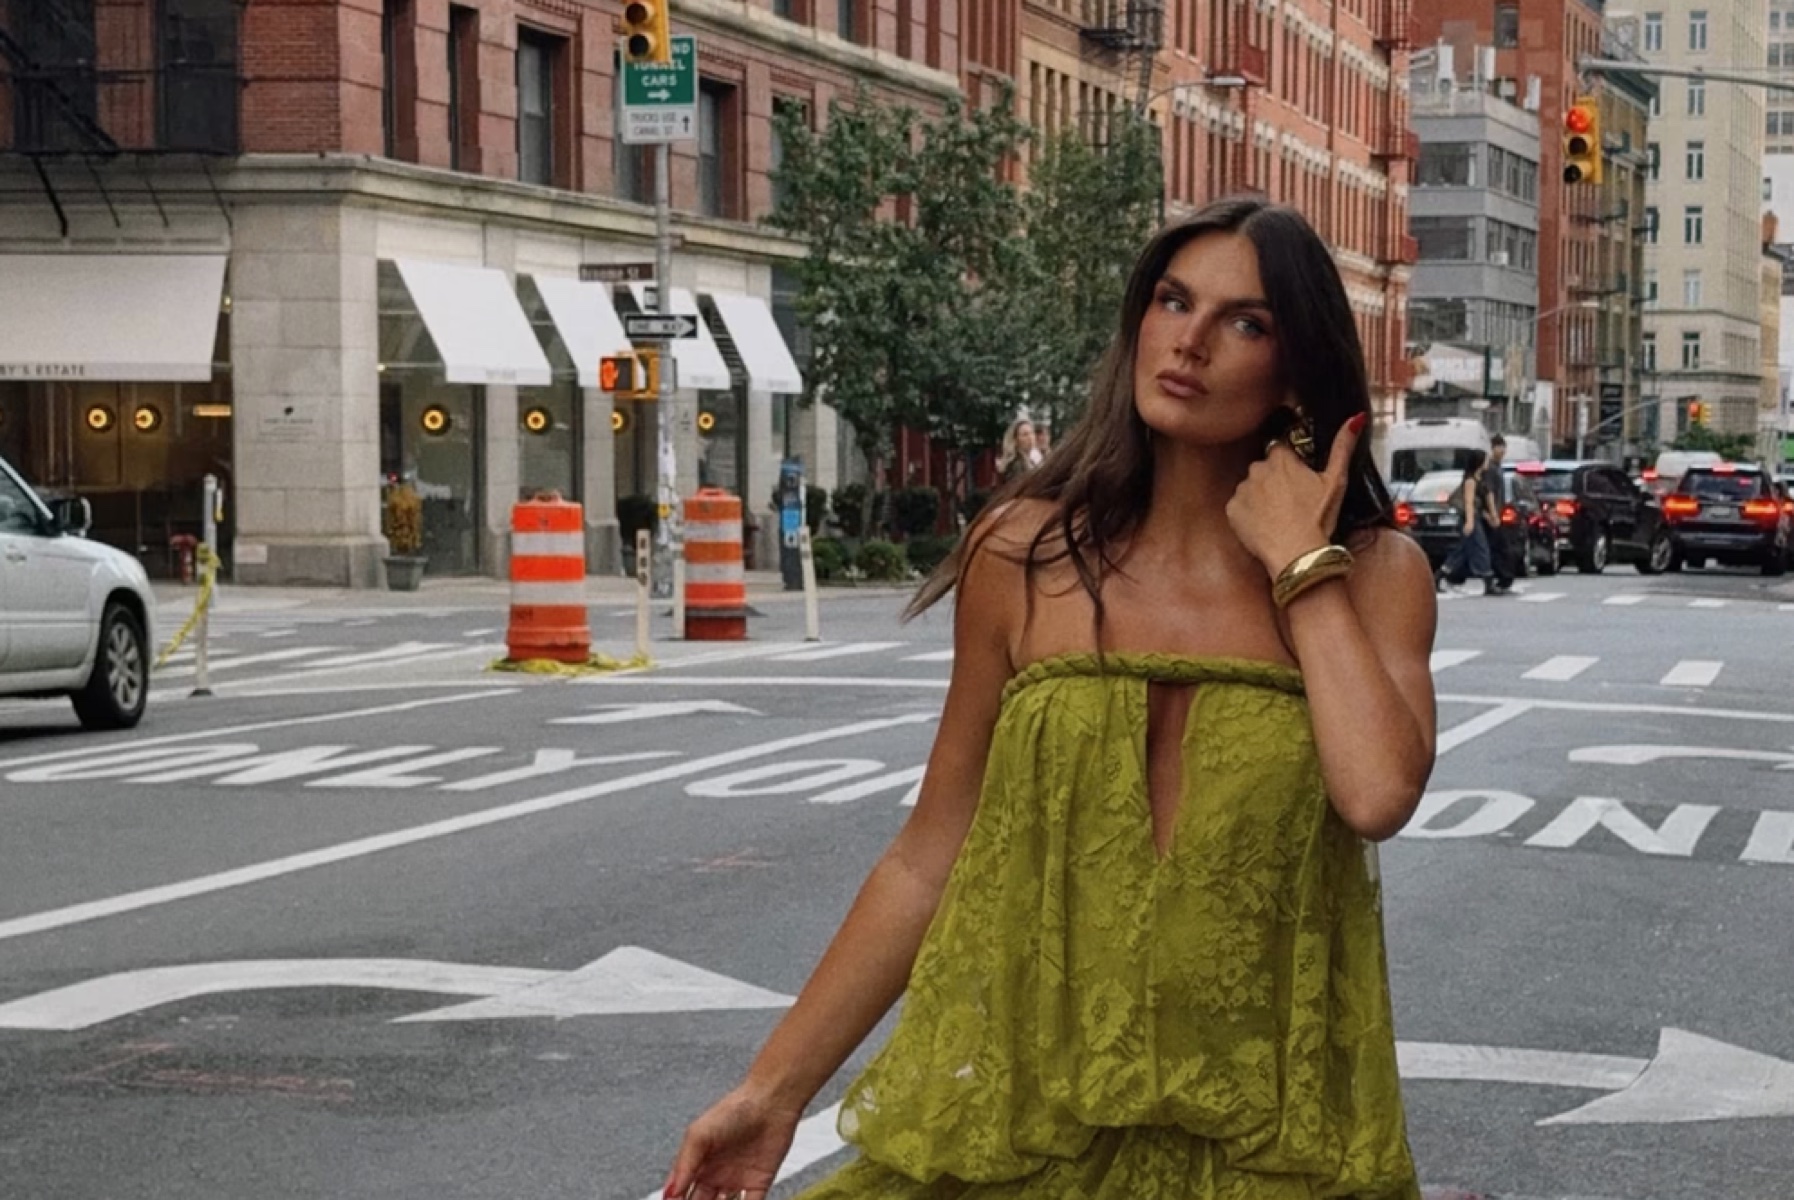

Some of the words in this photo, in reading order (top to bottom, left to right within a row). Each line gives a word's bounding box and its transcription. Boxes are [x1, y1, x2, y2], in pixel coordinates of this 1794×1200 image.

[641, 74, 677, 87] CARS
[35, 364, 85, 377] ESTATE
[5, 743, 683, 791] ONLY
[684, 757, 927, 806] ON
